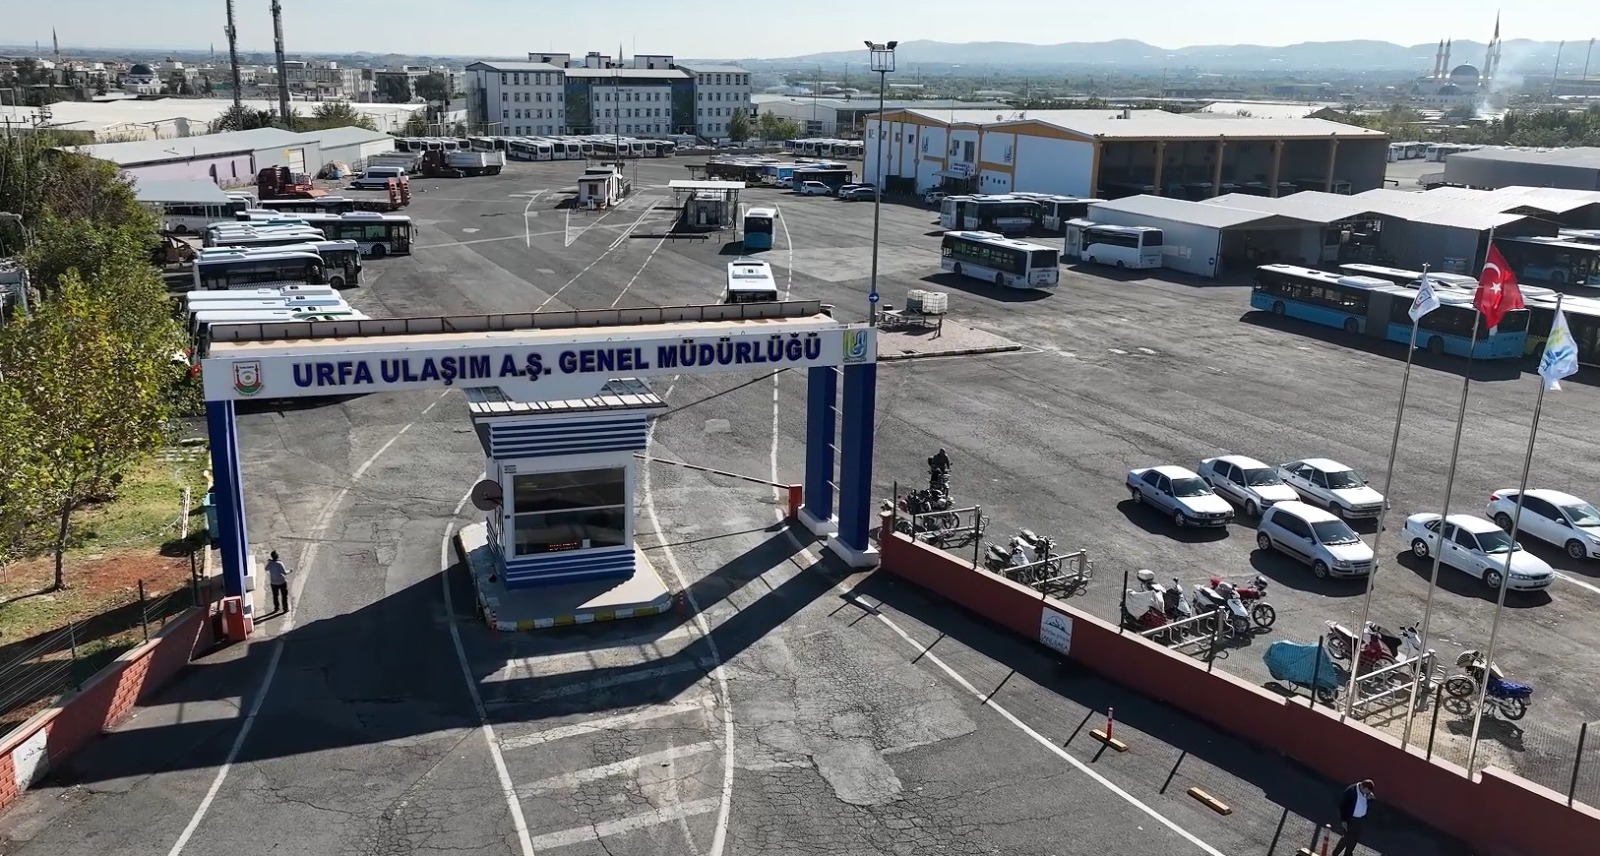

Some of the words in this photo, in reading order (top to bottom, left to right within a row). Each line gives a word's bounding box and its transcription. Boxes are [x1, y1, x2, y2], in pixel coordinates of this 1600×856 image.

[292, 360, 374, 388] URFA
[380, 354, 492, 386] ULAŞIM
[499, 353, 553, 382] A.Ş.
[559, 346, 650, 375] GENEL
[657, 331, 821, 369] MÜDÜRLÜĞÜ
